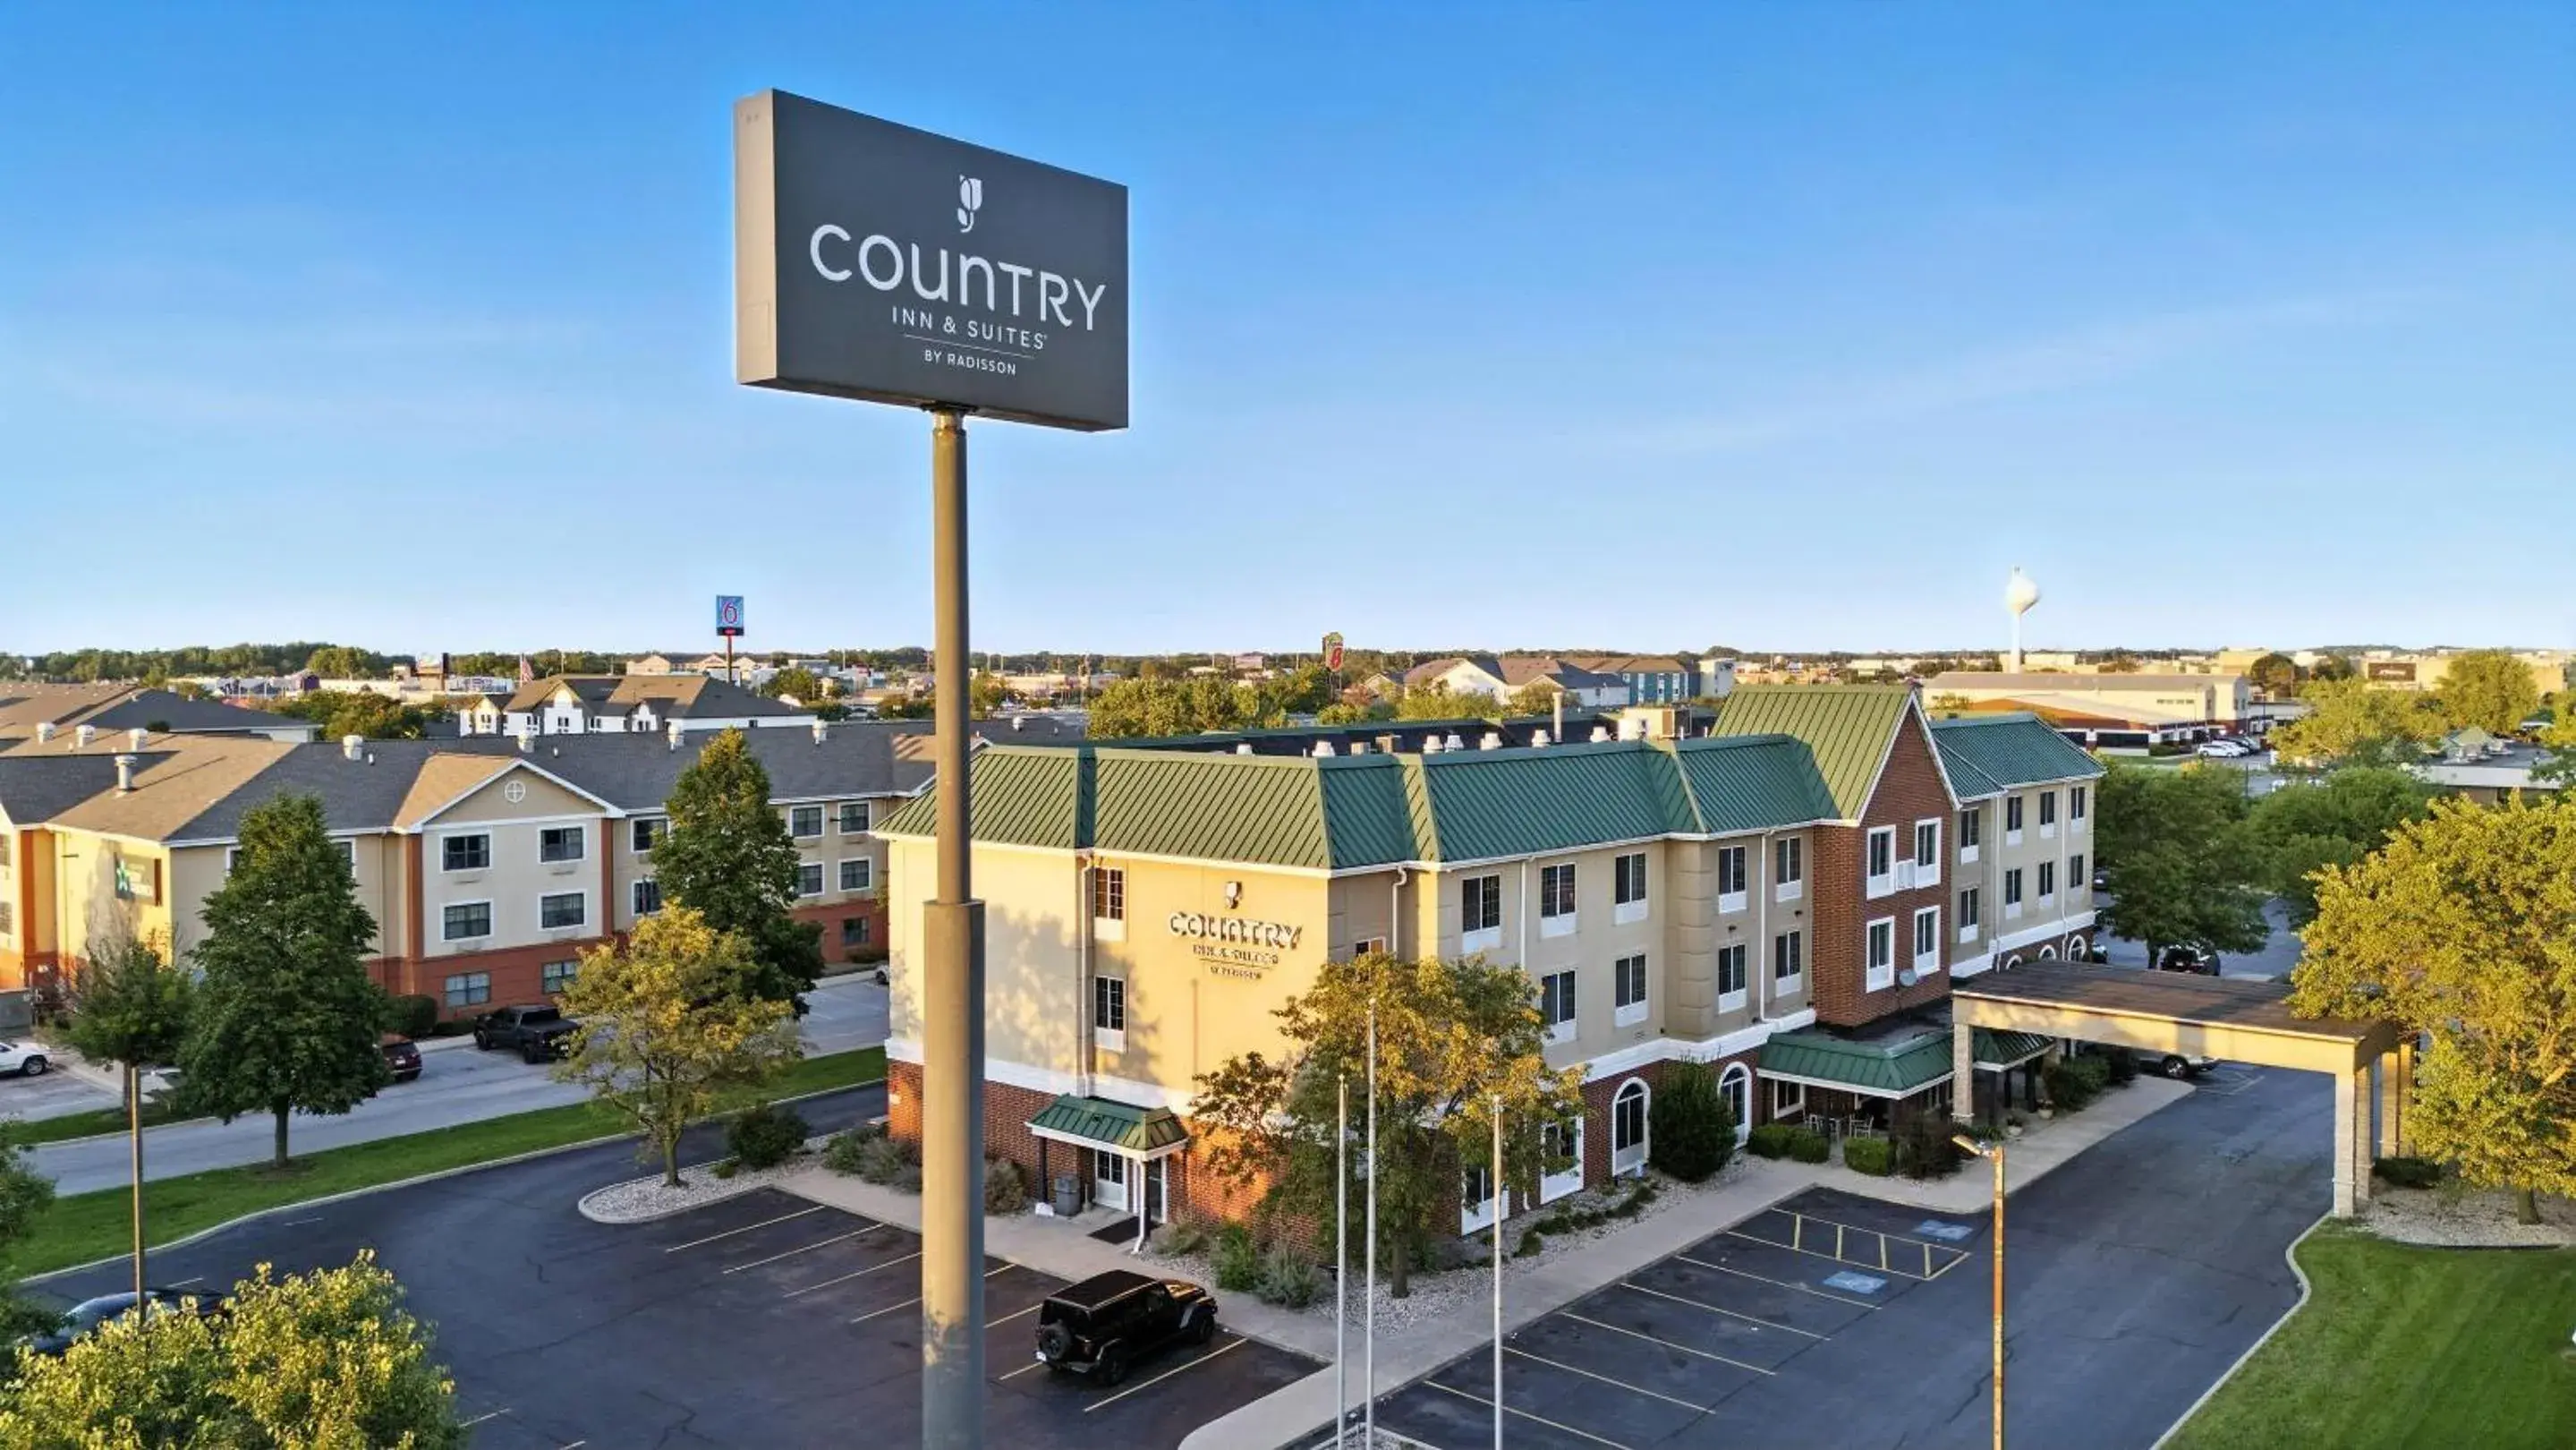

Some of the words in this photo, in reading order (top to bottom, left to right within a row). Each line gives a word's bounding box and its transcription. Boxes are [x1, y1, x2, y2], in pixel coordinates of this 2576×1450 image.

[892, 305, 932, 330] INN
[943, 315, 956, 335] &
[924, 349, 942, 363] BY
[948, 353, 1016, 376] RADISSON
[722, 601, 738, 625] 6
